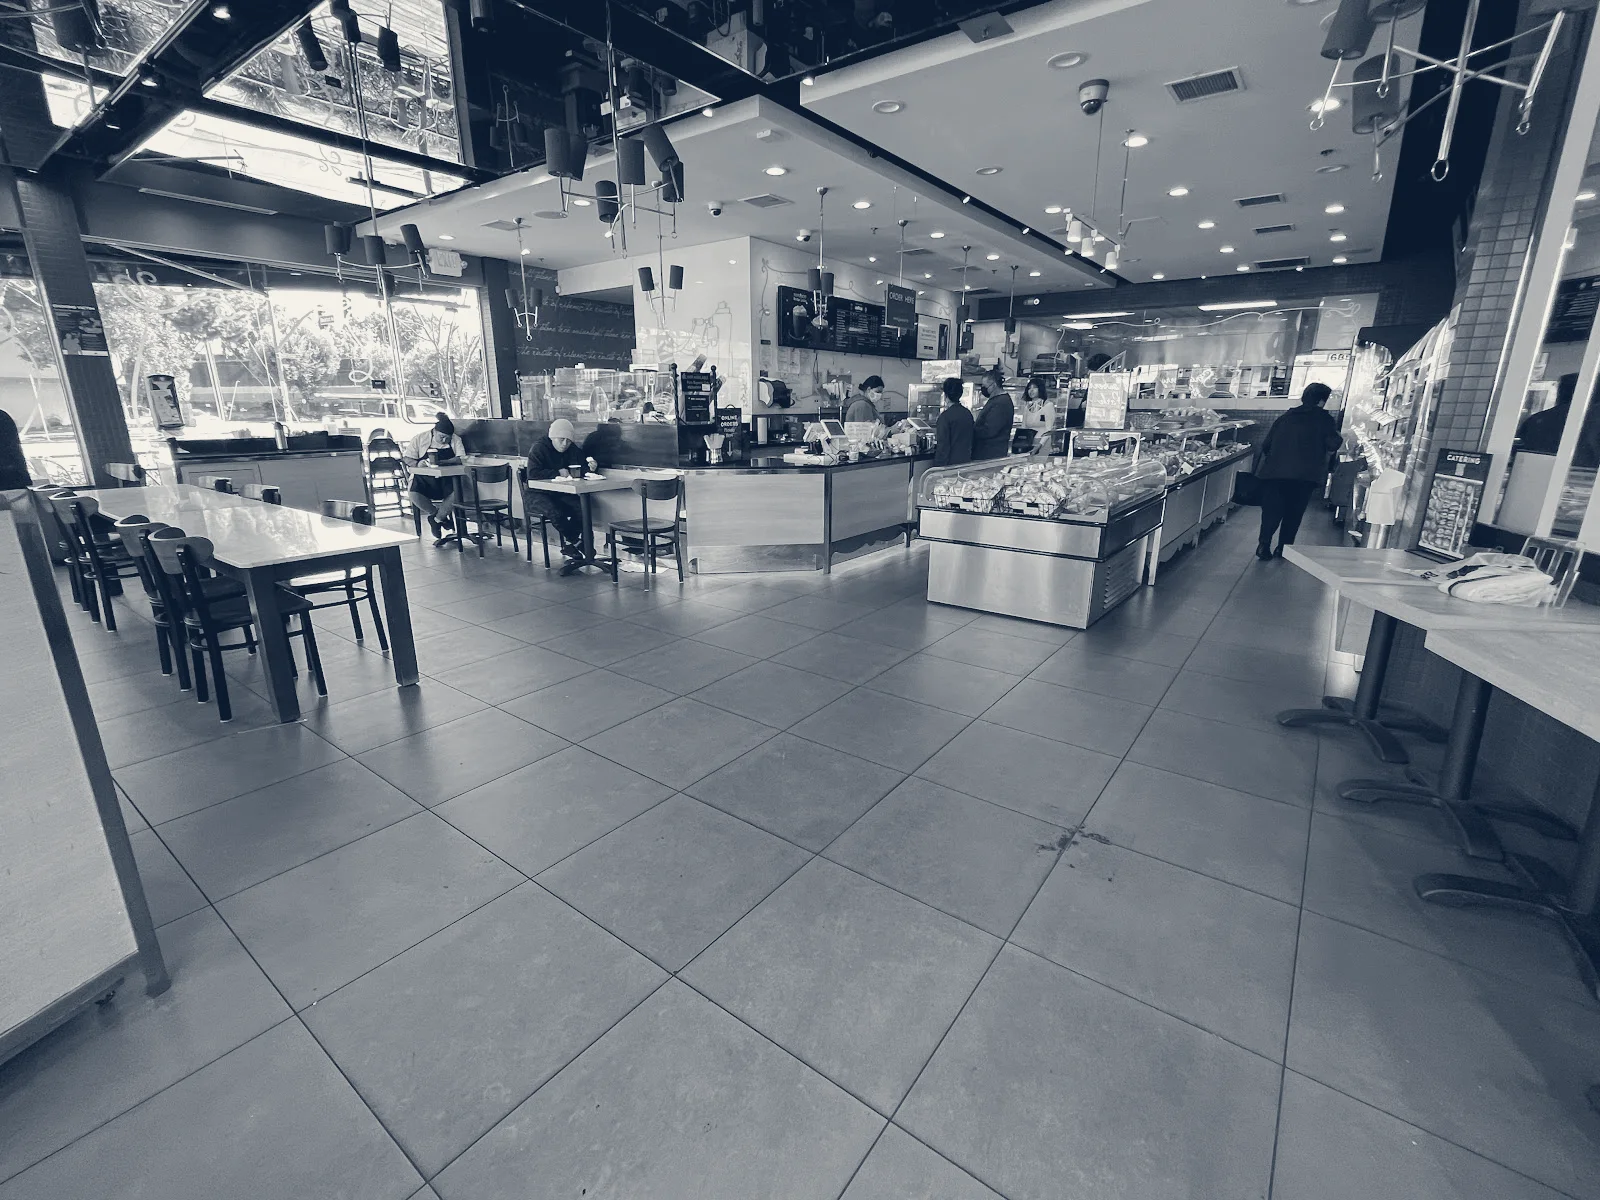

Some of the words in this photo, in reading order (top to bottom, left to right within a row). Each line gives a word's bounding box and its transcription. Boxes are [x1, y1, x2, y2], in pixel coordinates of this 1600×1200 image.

[889, 291, 903, 302] ORDER
[904, 296, 915, 305] HERE
[1446, 454, 1481, 465] CATERING
